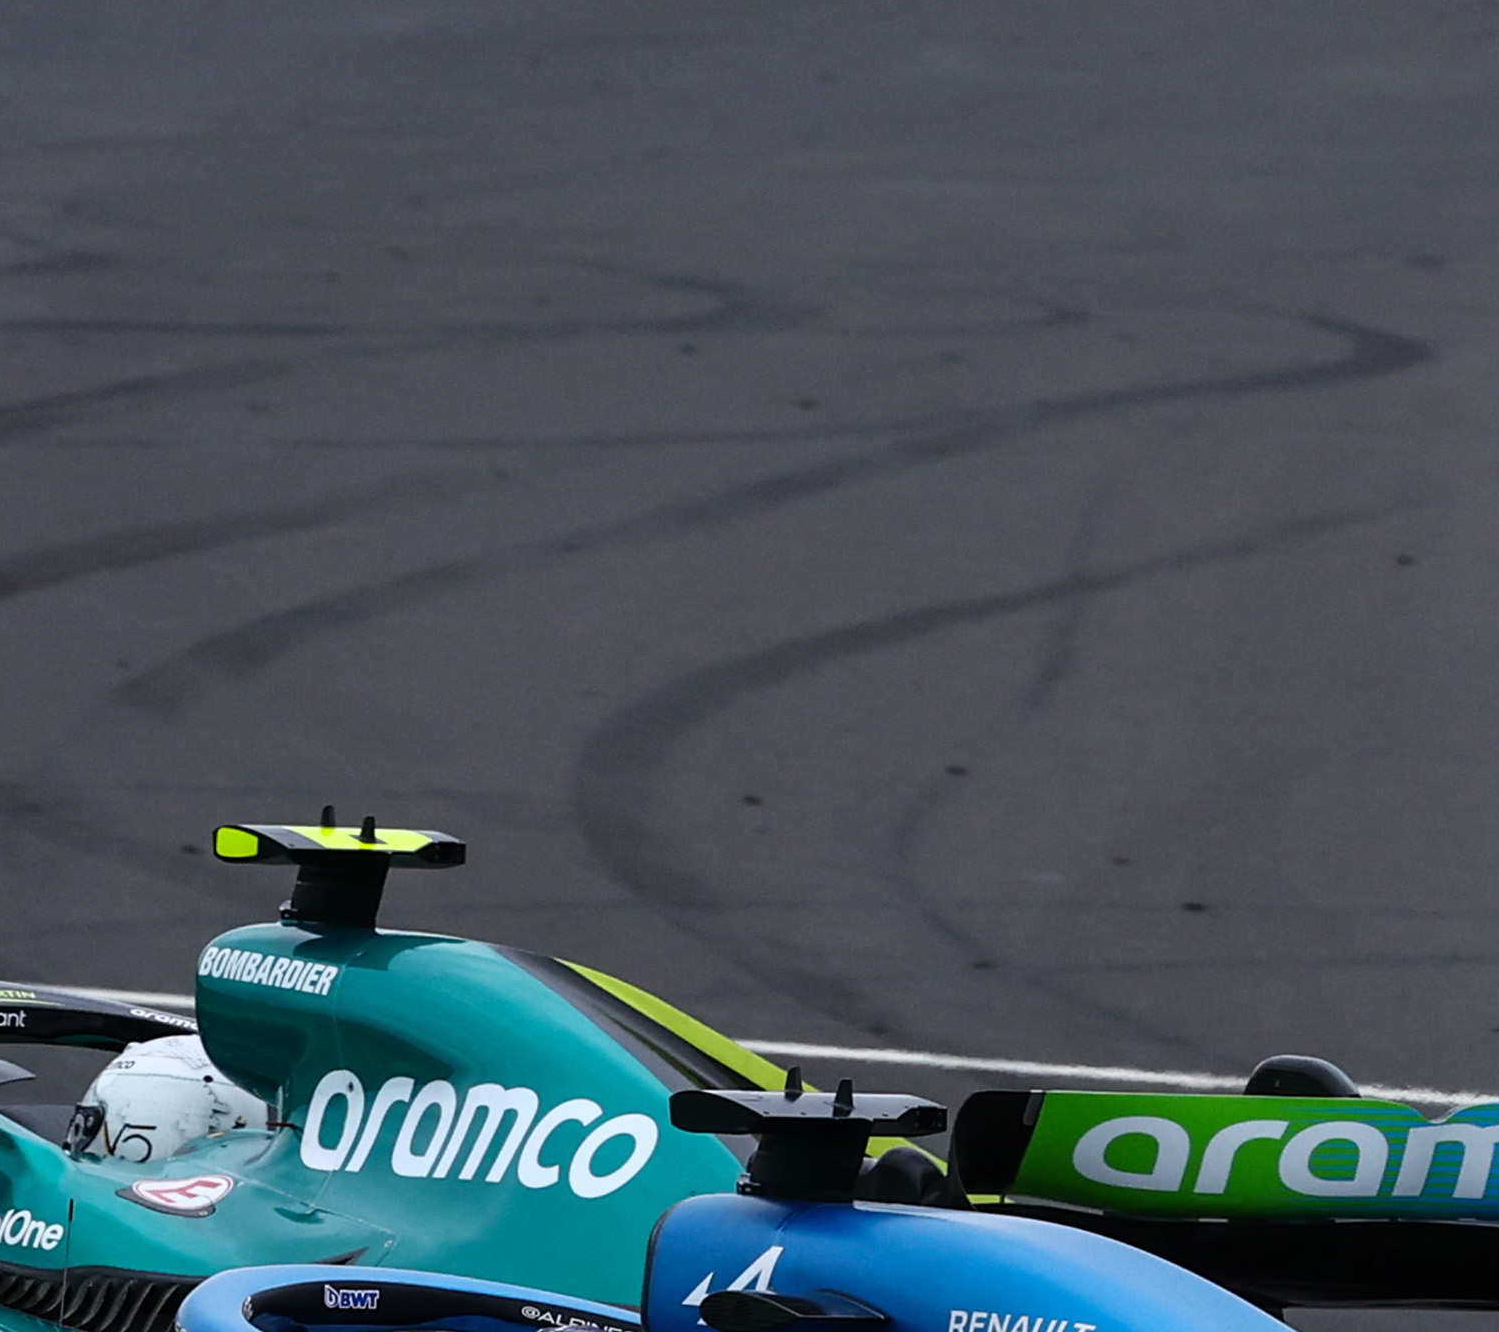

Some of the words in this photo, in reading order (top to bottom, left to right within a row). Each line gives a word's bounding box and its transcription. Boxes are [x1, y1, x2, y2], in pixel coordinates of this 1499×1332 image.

[198, 946, 339, 996] BOMBARDIER
[129, 1008, 200, 1030] aram
[299, 1068, 660, 1200] aramco
[338, 1289, 380, 1310] BWT
